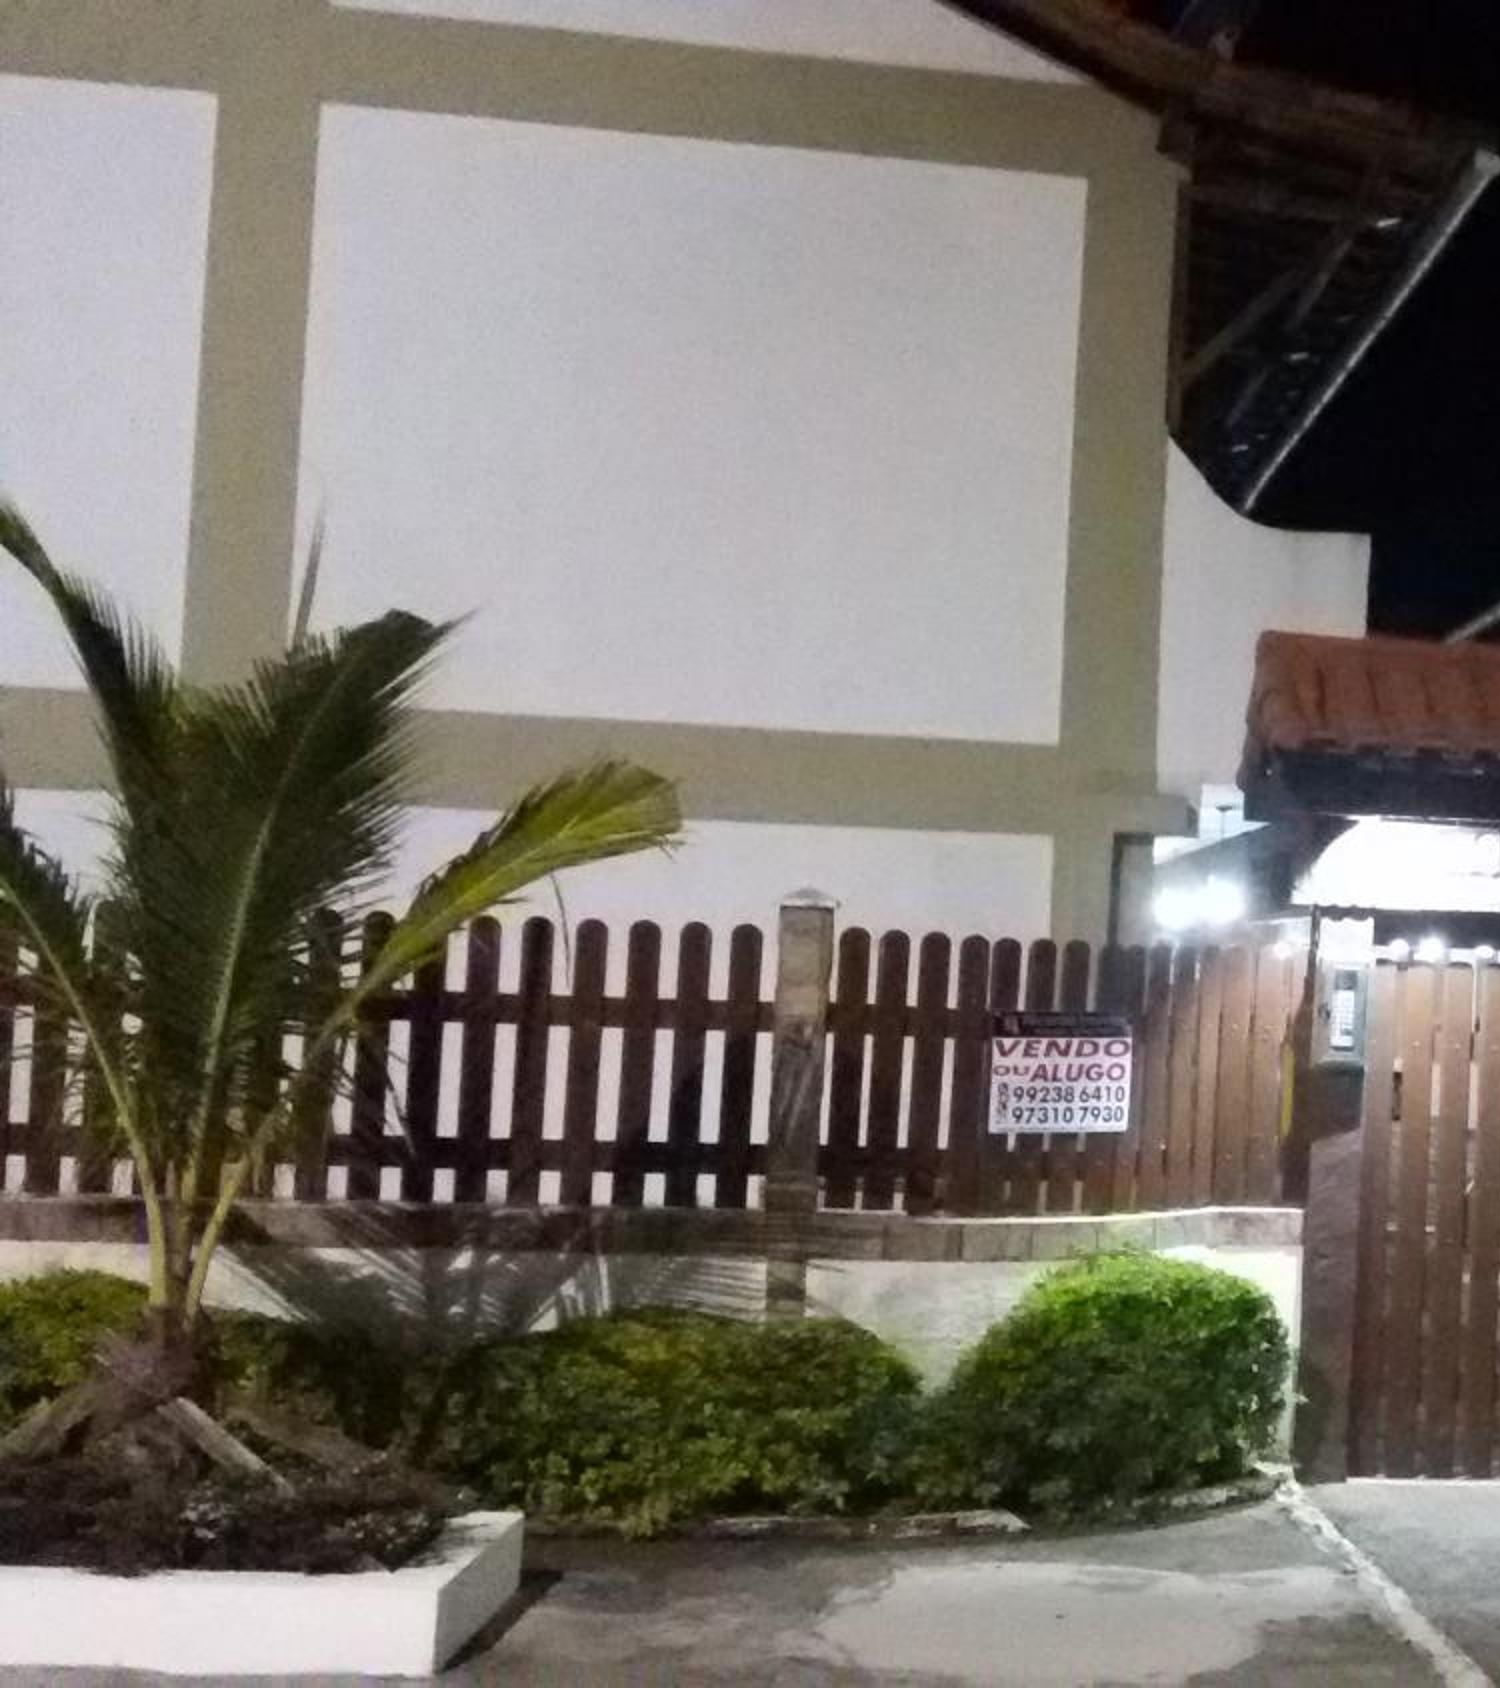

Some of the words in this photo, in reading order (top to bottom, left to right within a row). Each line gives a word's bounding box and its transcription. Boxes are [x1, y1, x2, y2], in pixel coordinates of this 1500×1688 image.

[995, 1039, 1130, 1058] VENDO
[993, 1065, 1029, 1077] OU
[1030, 1063, 1126, 1082] ALUGO
[1013, 1086, 1075, 1104] 99238
[1079, 1086, 1126, 1103] 6410
[1012, 1106, 1074, 1125] 97310
[1079, 1106, 1124, 1124] 7930
